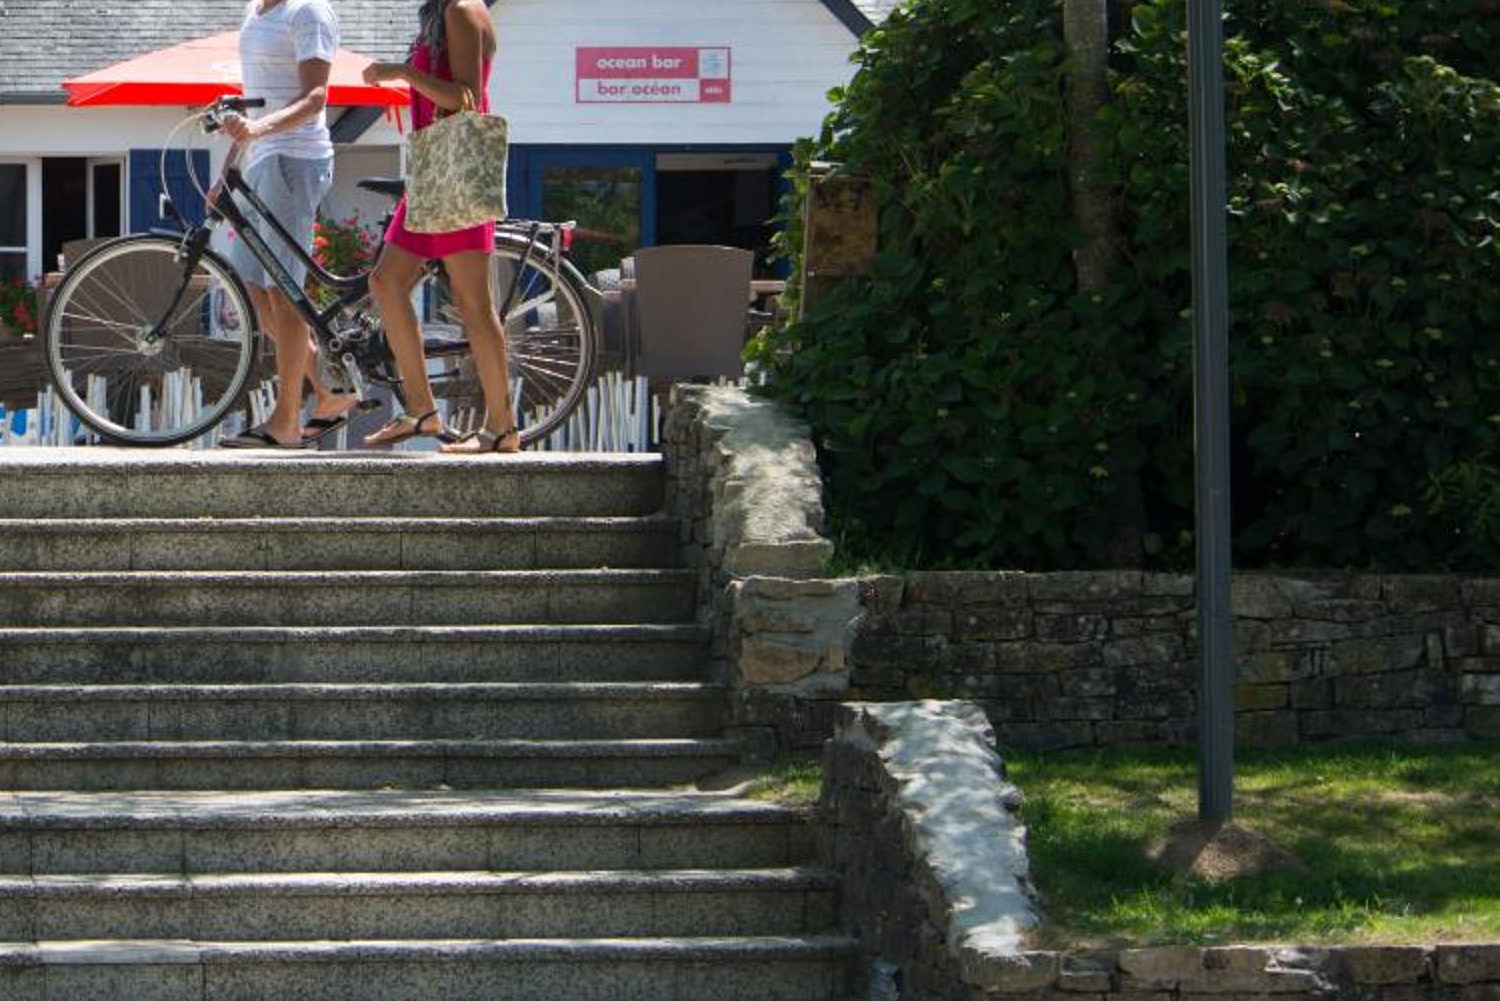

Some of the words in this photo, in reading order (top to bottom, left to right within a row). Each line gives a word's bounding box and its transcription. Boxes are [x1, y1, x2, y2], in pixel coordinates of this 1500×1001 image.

[596, 57, 647, 69] ocean
[652, 54, 683, 69] bar
[597, 81, 627, 95] bar
